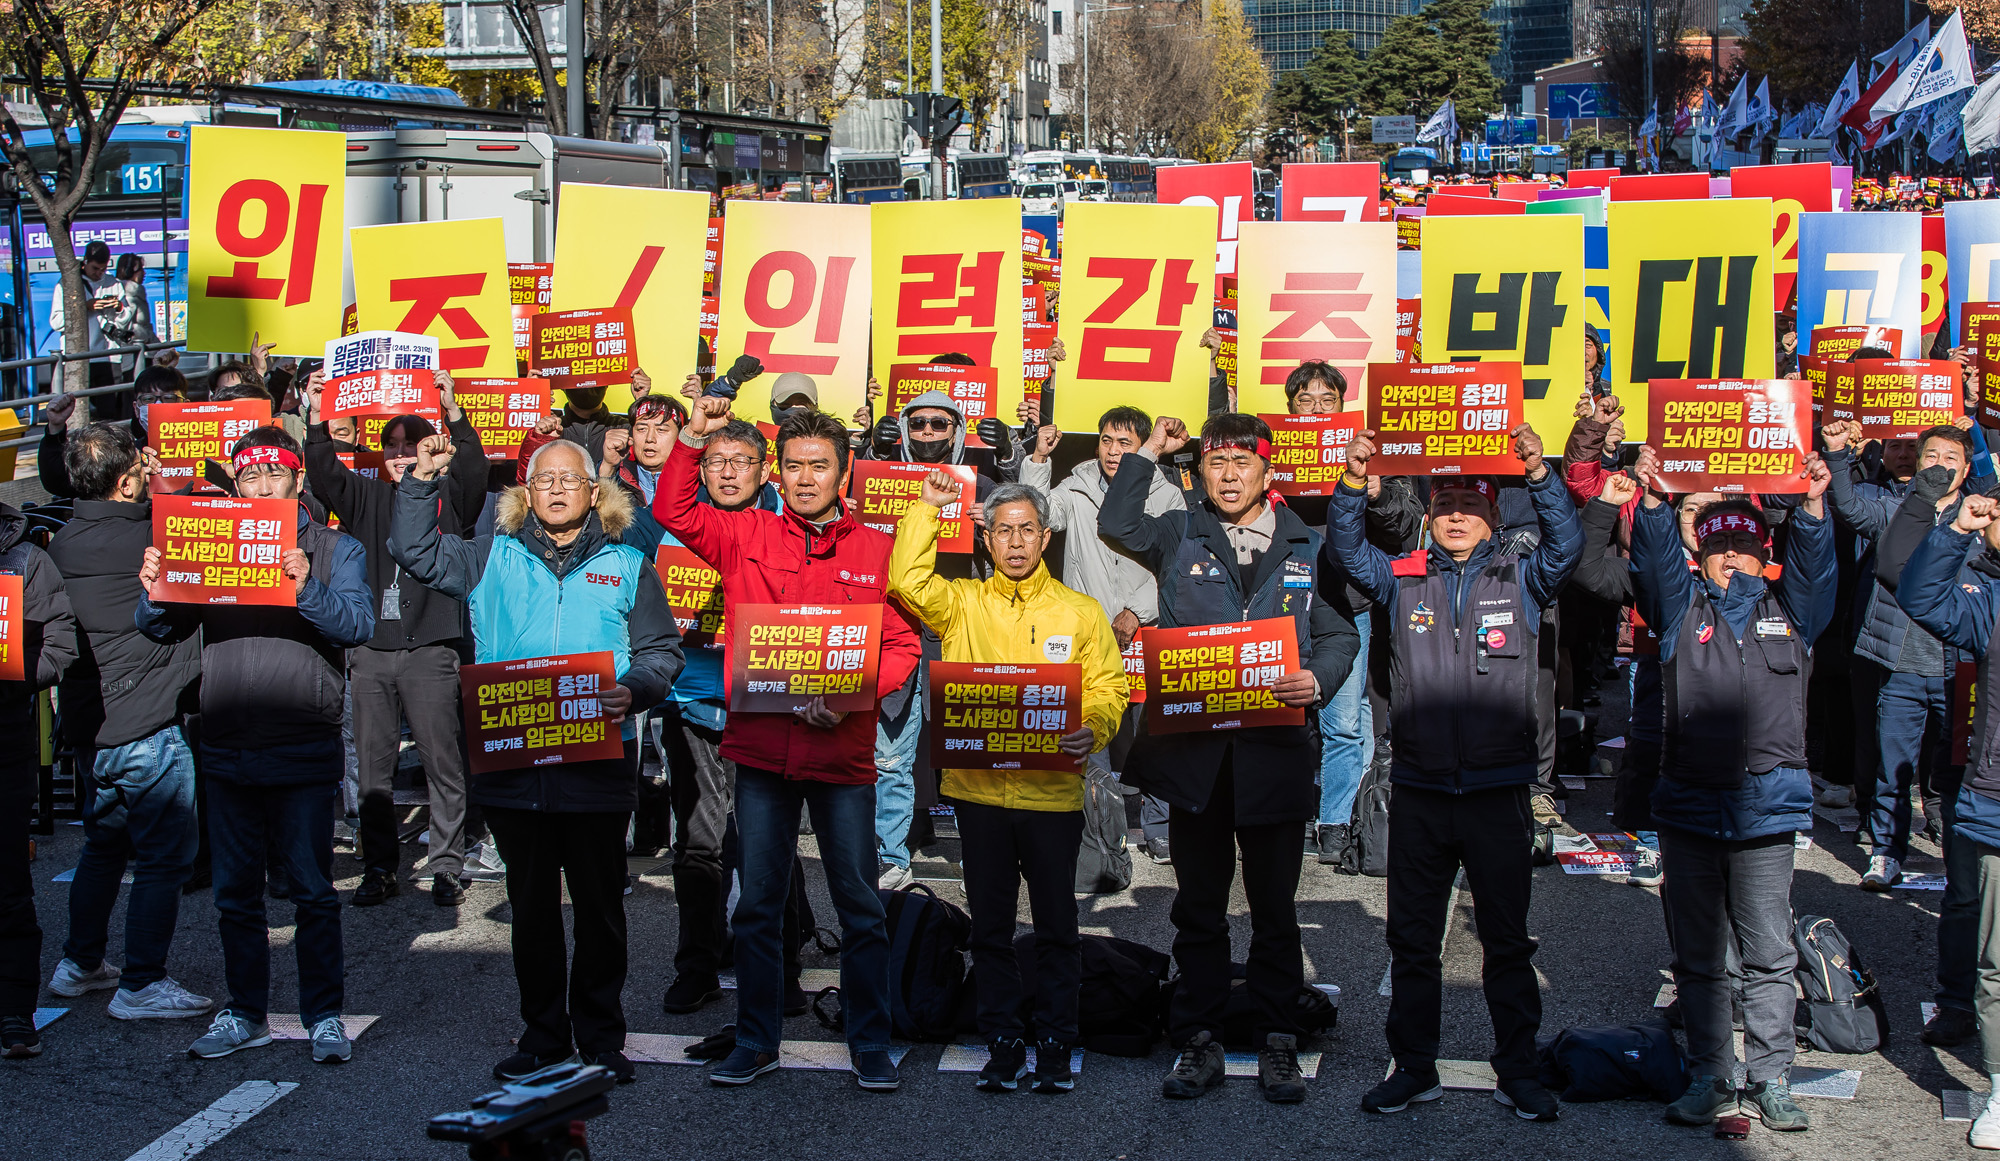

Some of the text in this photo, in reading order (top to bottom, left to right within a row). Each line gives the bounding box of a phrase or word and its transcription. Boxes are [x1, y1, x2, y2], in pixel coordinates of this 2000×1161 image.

[125, 166, 162, 191] 151
[207, 179, 328, 306] 외
[744, 251, 856, 375] 인
[896, 251, 1004, 368] 력
[1077, 257, 1199, 382] 감
[1217, 313, 1227, 324] M
[1631, 255, 1758, 383] 대
[541, 322, 624, 343] 안전인력 충원!
[1447, 272, 1568, 399] 반
[334, 337, 391, 361] 임금체불
[540, 339, 626, 360] 노사합의 이행!
[1817, 339, 1862, 353] 안전인력
[395, 354, 431, 370] 해결!
[542, 357, 628, 376] 정부기준 임금인상!
[339, 374, 412, 396] 외주화 중단!
[896, 379, 986, 398] 안전인력 충원!
[1863, 374, 1952, 390] 안전인력 충원!
[334, 389, 422, 412] 안전인력 충원!
[508, 394, 540, 409] 충원!
[1380, 384, 1508, 406] 안전인력 충원!
[1862, 392, 1953, 408] 노사합의 이행!
[508, 412, 540, 428] 이행!
[1380, 409, 1508, 432] 노사합의 이행!
[1664, 401, 1795, 424] 안전인력 충원!
[1862, 410, 1953, 425] 정부기준 임금인상!
[159, 420, 258, 439] 안전인력 충원!
[1322, 428, 1354, 446] 충원!
[1662, 427, 1795, 450] 노사합의 이행!
[160, 440, 220, 458] 노사합의
[1382, 434, 1508, 456] 정부기준 임금인상!
[1271, 449, 1318, 464] 사합의
[1663, 452, 1795, 475] 정부기준 임금인상!
[161, 467, 194, 477] 정부기준
[865, 477, 924, 497] 안전인력
[166, 516, 282, 540] 안전인력 충원!
[1698, 515, 1756, 538] 단결투쟁
[166, 540, 281, 564] 노사합의 이행!
[166, 566, 281, 588] 정부기준 임금인상!
[586, 572, 622, 587] 진보당
[853, 573, 876, 584] 노동당
[750, 625, 868, 646] 안전인력 충원!
[1048, 643, 1067, 652] 정의당
[1159, 640, 1282, 670] 안전인력 충원!
[748, 649, 866, 671] 노사합의 이행!
[478, 674, 600, 705] 안전인력 충원!
[748, 673, 863, 695] 정부기준 임금인상!
[1160, 669, 1236, 693] 노사합의
[944, 683, 1066, 706] 안전인력 충원!
[481, 697, 603, 730] 노사합의 이행!
[944, 708, 1067, 730] 노사합의 이행!
[1163, 702, 1202, 715] 정부기준
[484, 722, 605, 752] 정부기준 임금인상!
[945, 738, 984, 750] 정부기준
